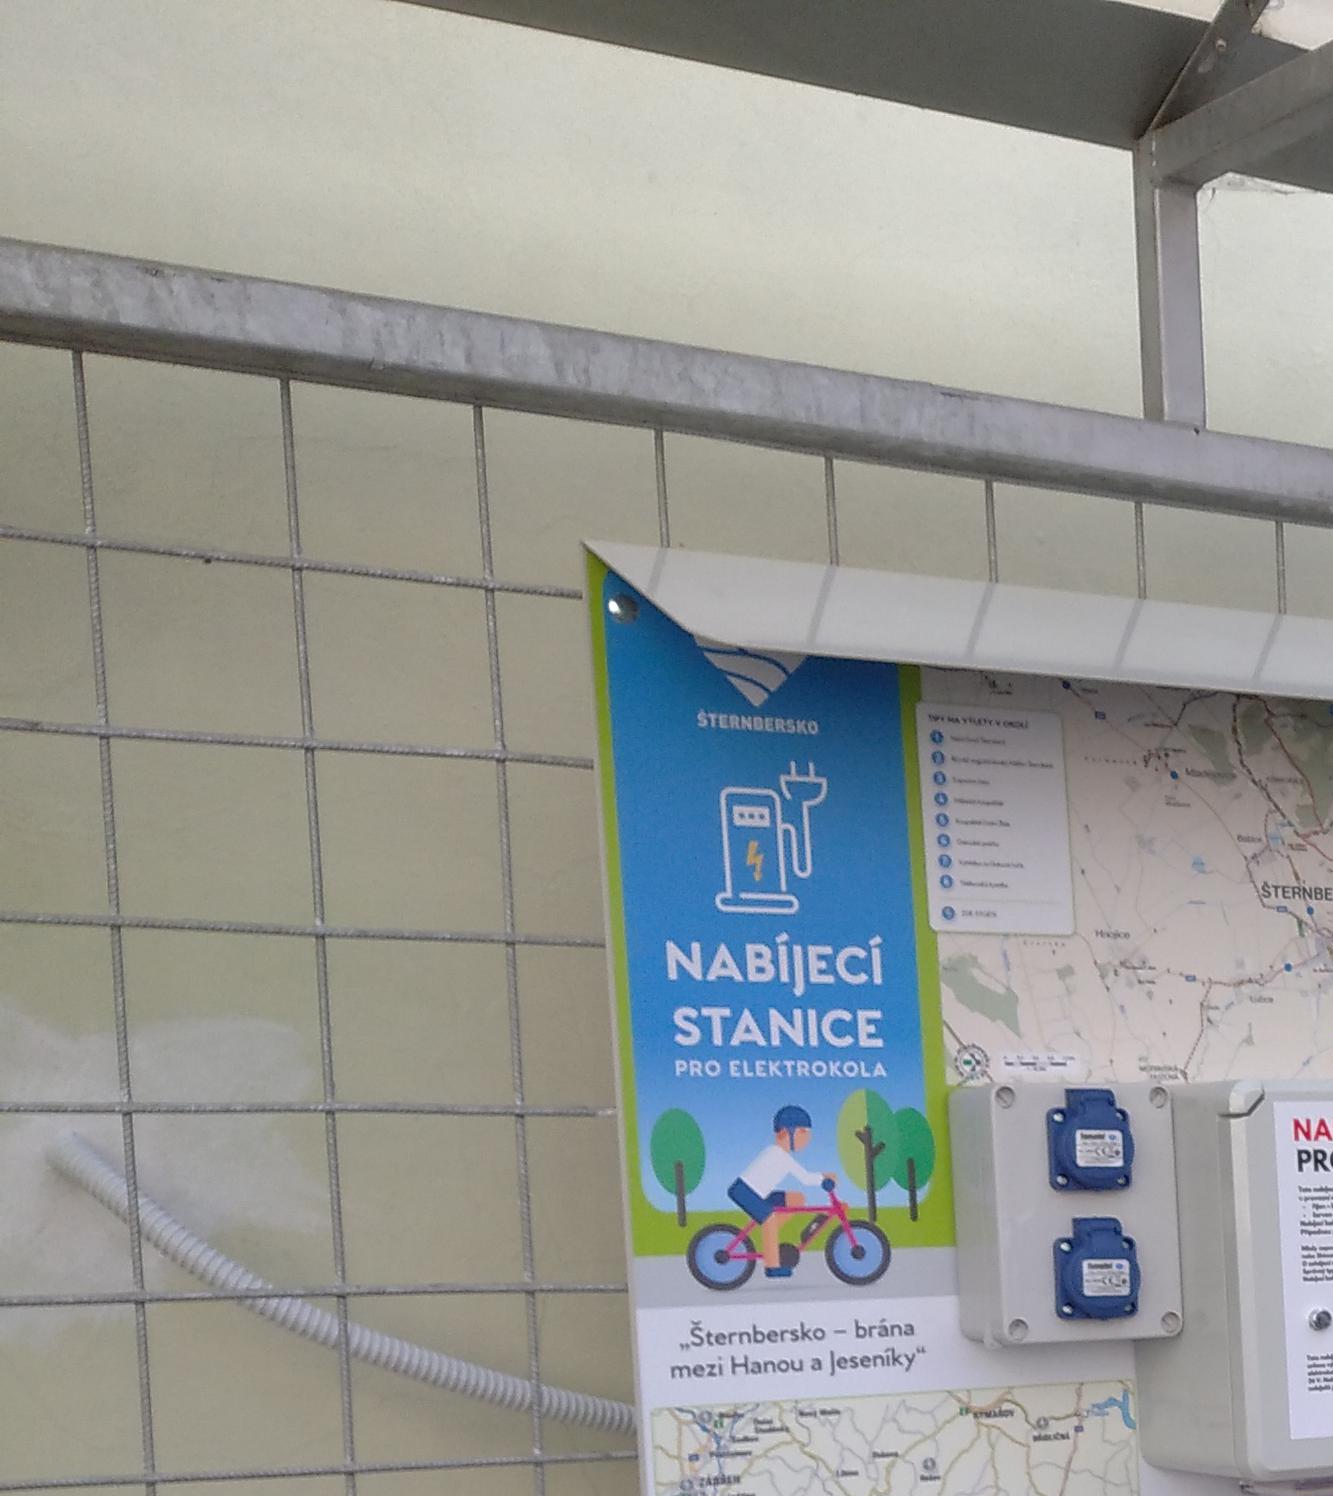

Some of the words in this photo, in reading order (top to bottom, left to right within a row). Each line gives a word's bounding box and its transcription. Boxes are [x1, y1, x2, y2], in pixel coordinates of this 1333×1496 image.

[696, 709, 819, 735] ŠTERNBERSKO
[665, 932, 883, 997] NABÍJECÍ
[672, 1006, 884, 1049] STANICE
[674, 1059, 721, 1078] PRO
[729, 1060, 887, 1078] ELEKTROKOLA
[679, 1320, 827, 1351] „Šternbersko
[854, 1318, 915, 1340] brána
[670, 1357, 724, 1380] mezi
[730, 1355, 804, 1377] Hanou
[810, 1358, 823, 1372] a
[828, 1345, 927, 1377] Jeseníky“
